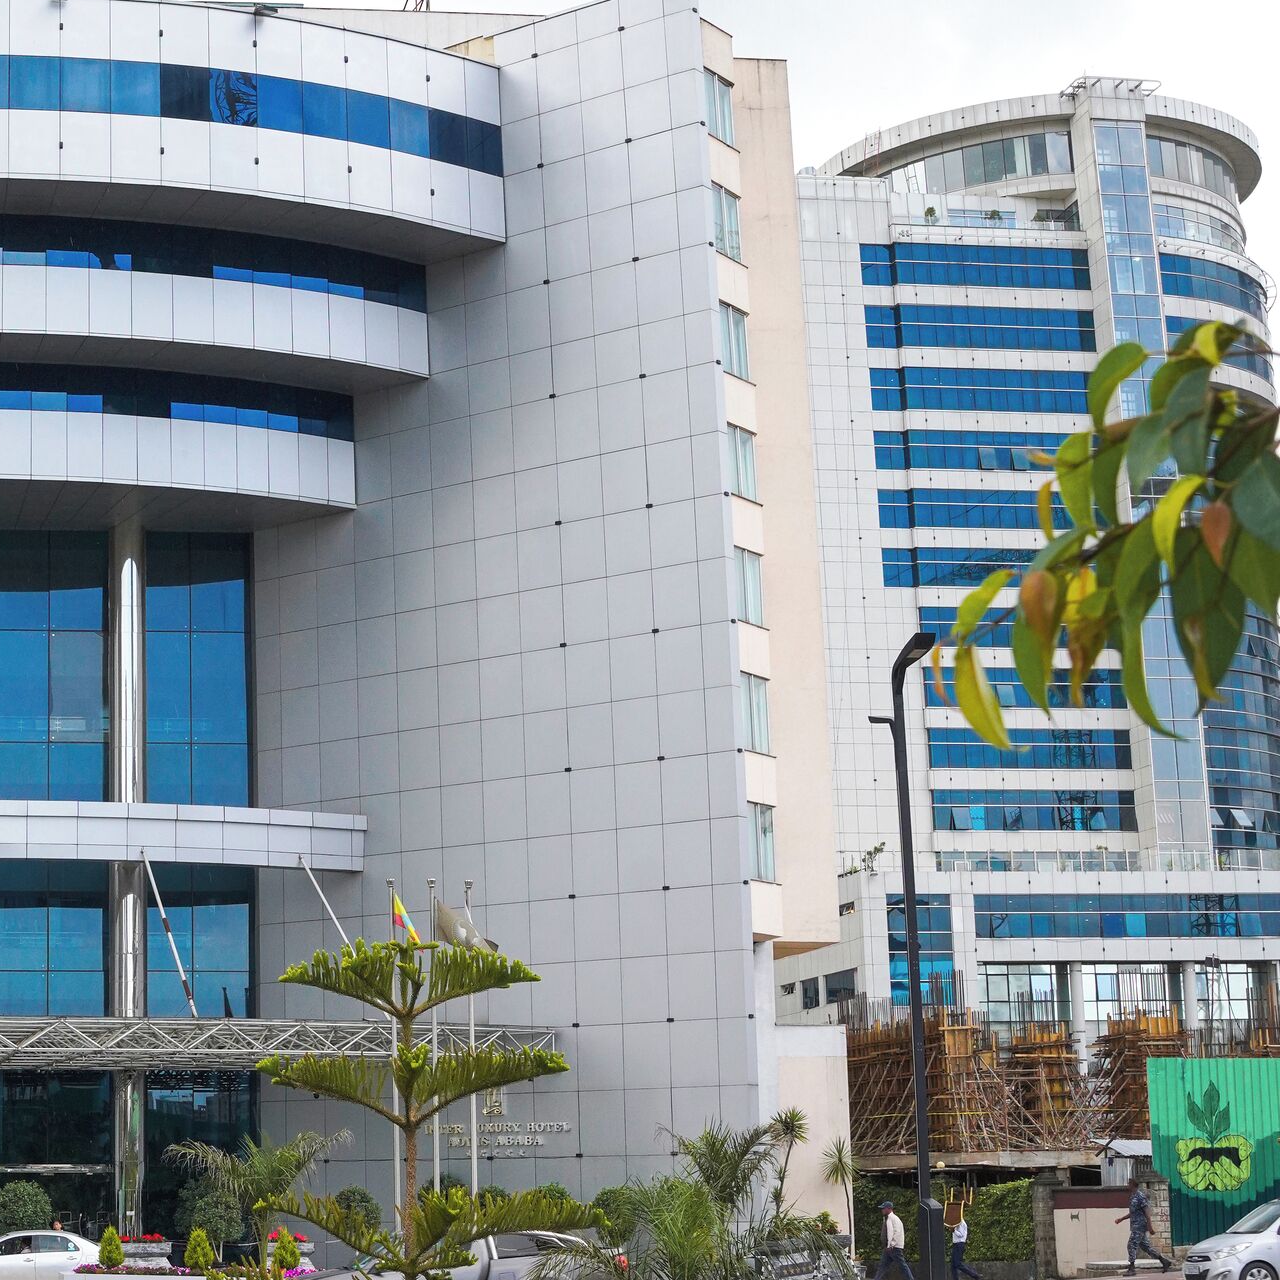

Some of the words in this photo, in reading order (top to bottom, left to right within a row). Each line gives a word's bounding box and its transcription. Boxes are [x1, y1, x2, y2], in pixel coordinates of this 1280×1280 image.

[424, 1124, 463, 1135] INTER
[472, 1123, 521, 1133] UXURY
[527, 1122, 571, 1132] HOTEL
[495, 1136, 544, 1146] ABABA
